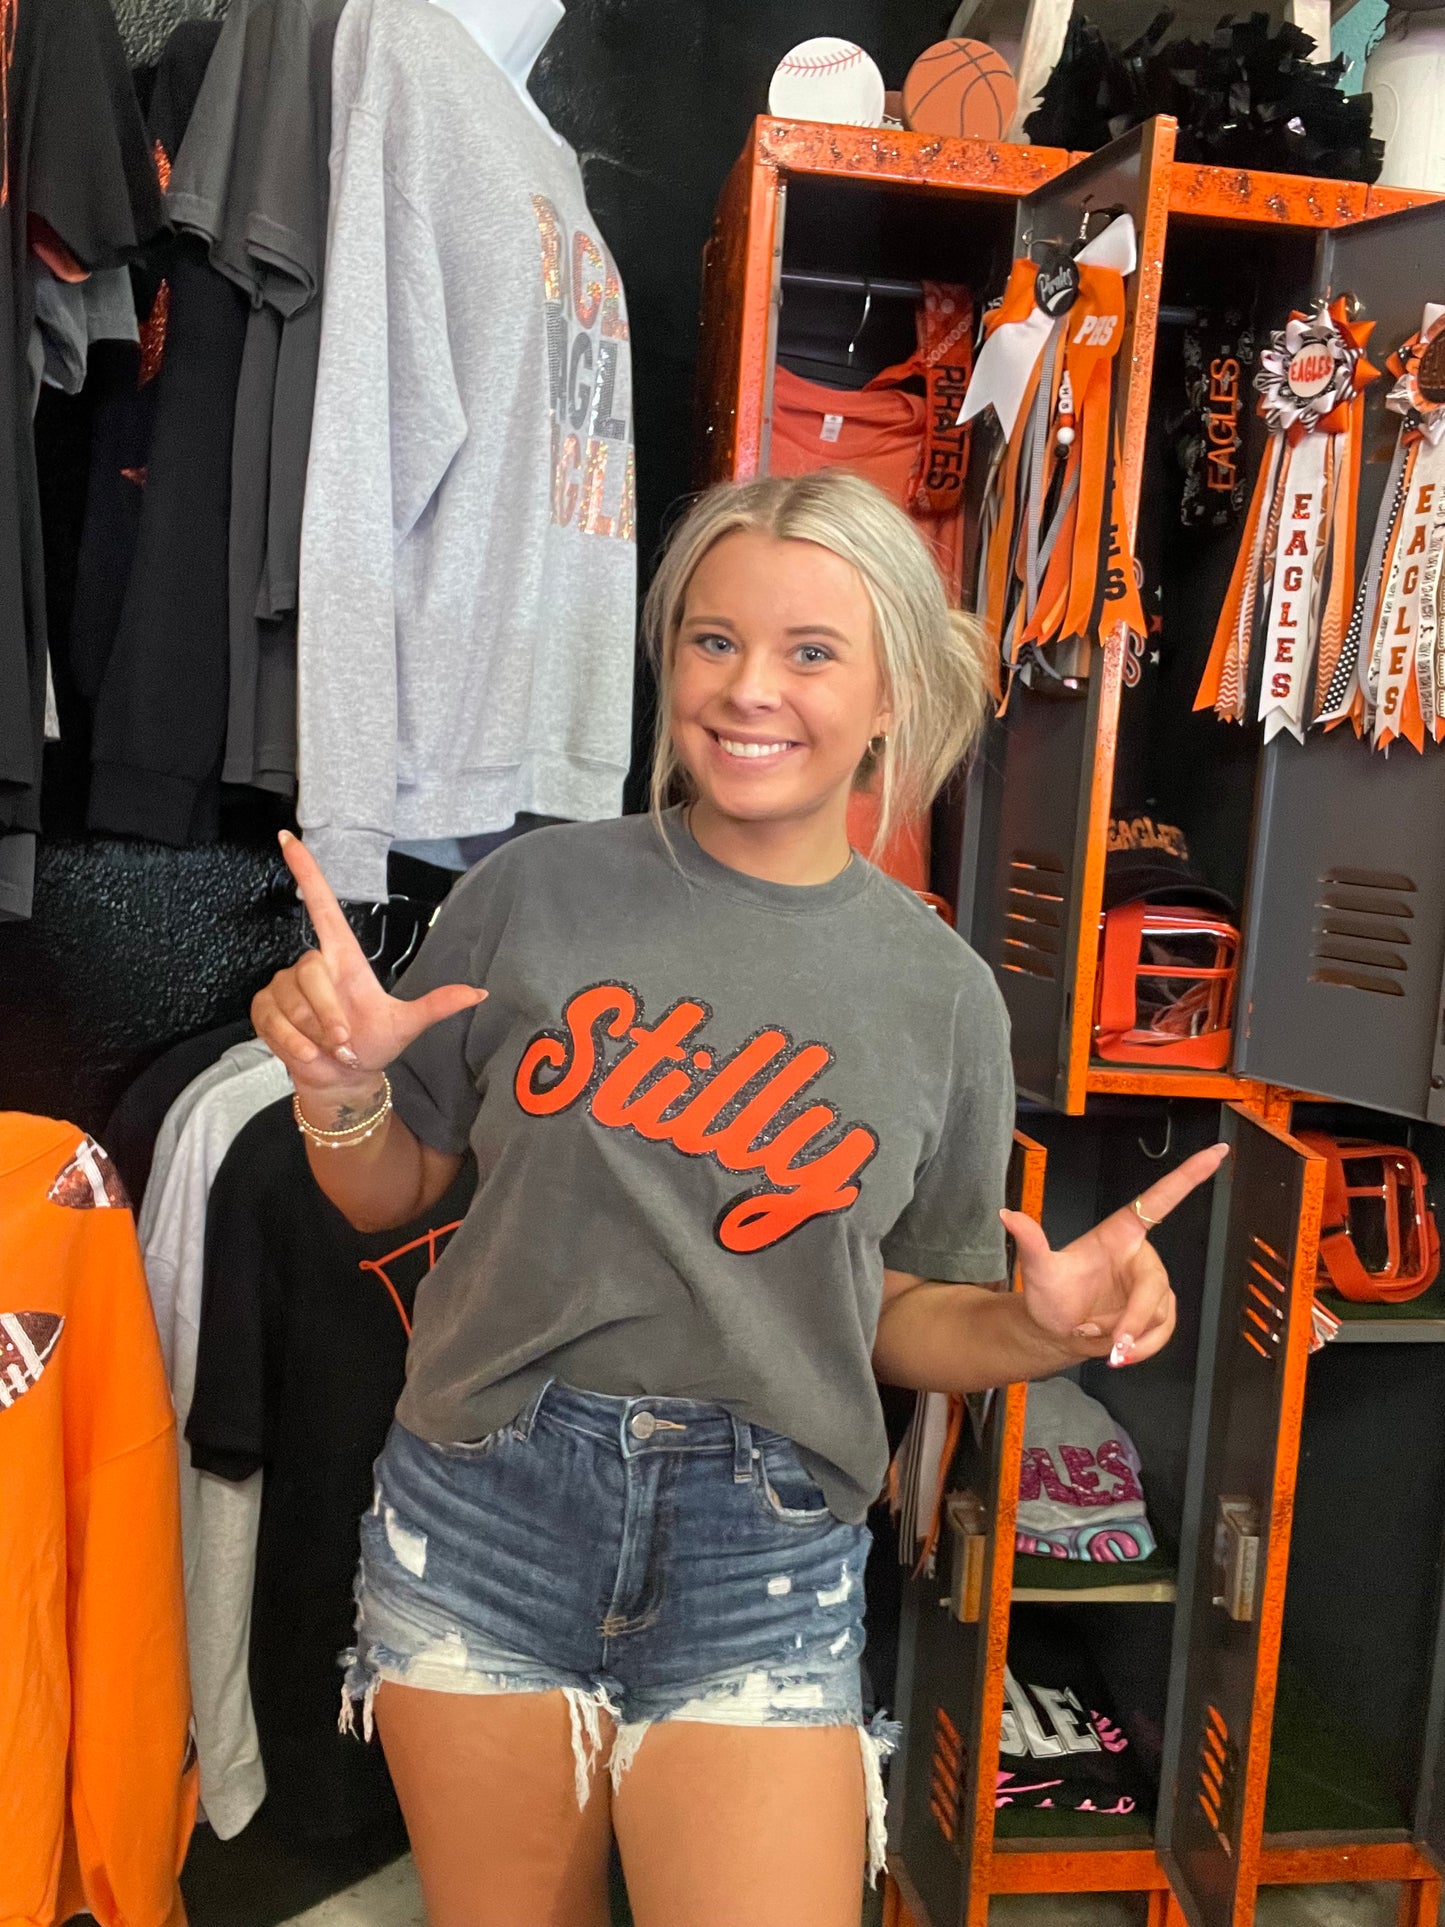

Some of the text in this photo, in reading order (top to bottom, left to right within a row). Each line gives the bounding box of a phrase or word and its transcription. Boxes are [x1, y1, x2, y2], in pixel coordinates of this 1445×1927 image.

[1072, 315, 1118, 346] PHS
[1288, 354, 1332, 383] EAGLES
[1207, 357, 1240, 491] EAGLES
[1271, 493, 1313, 698] EAGLES
[1383, 483, 1436, 715] EAGLES
[514, 979, 880, 1254] Stilly
